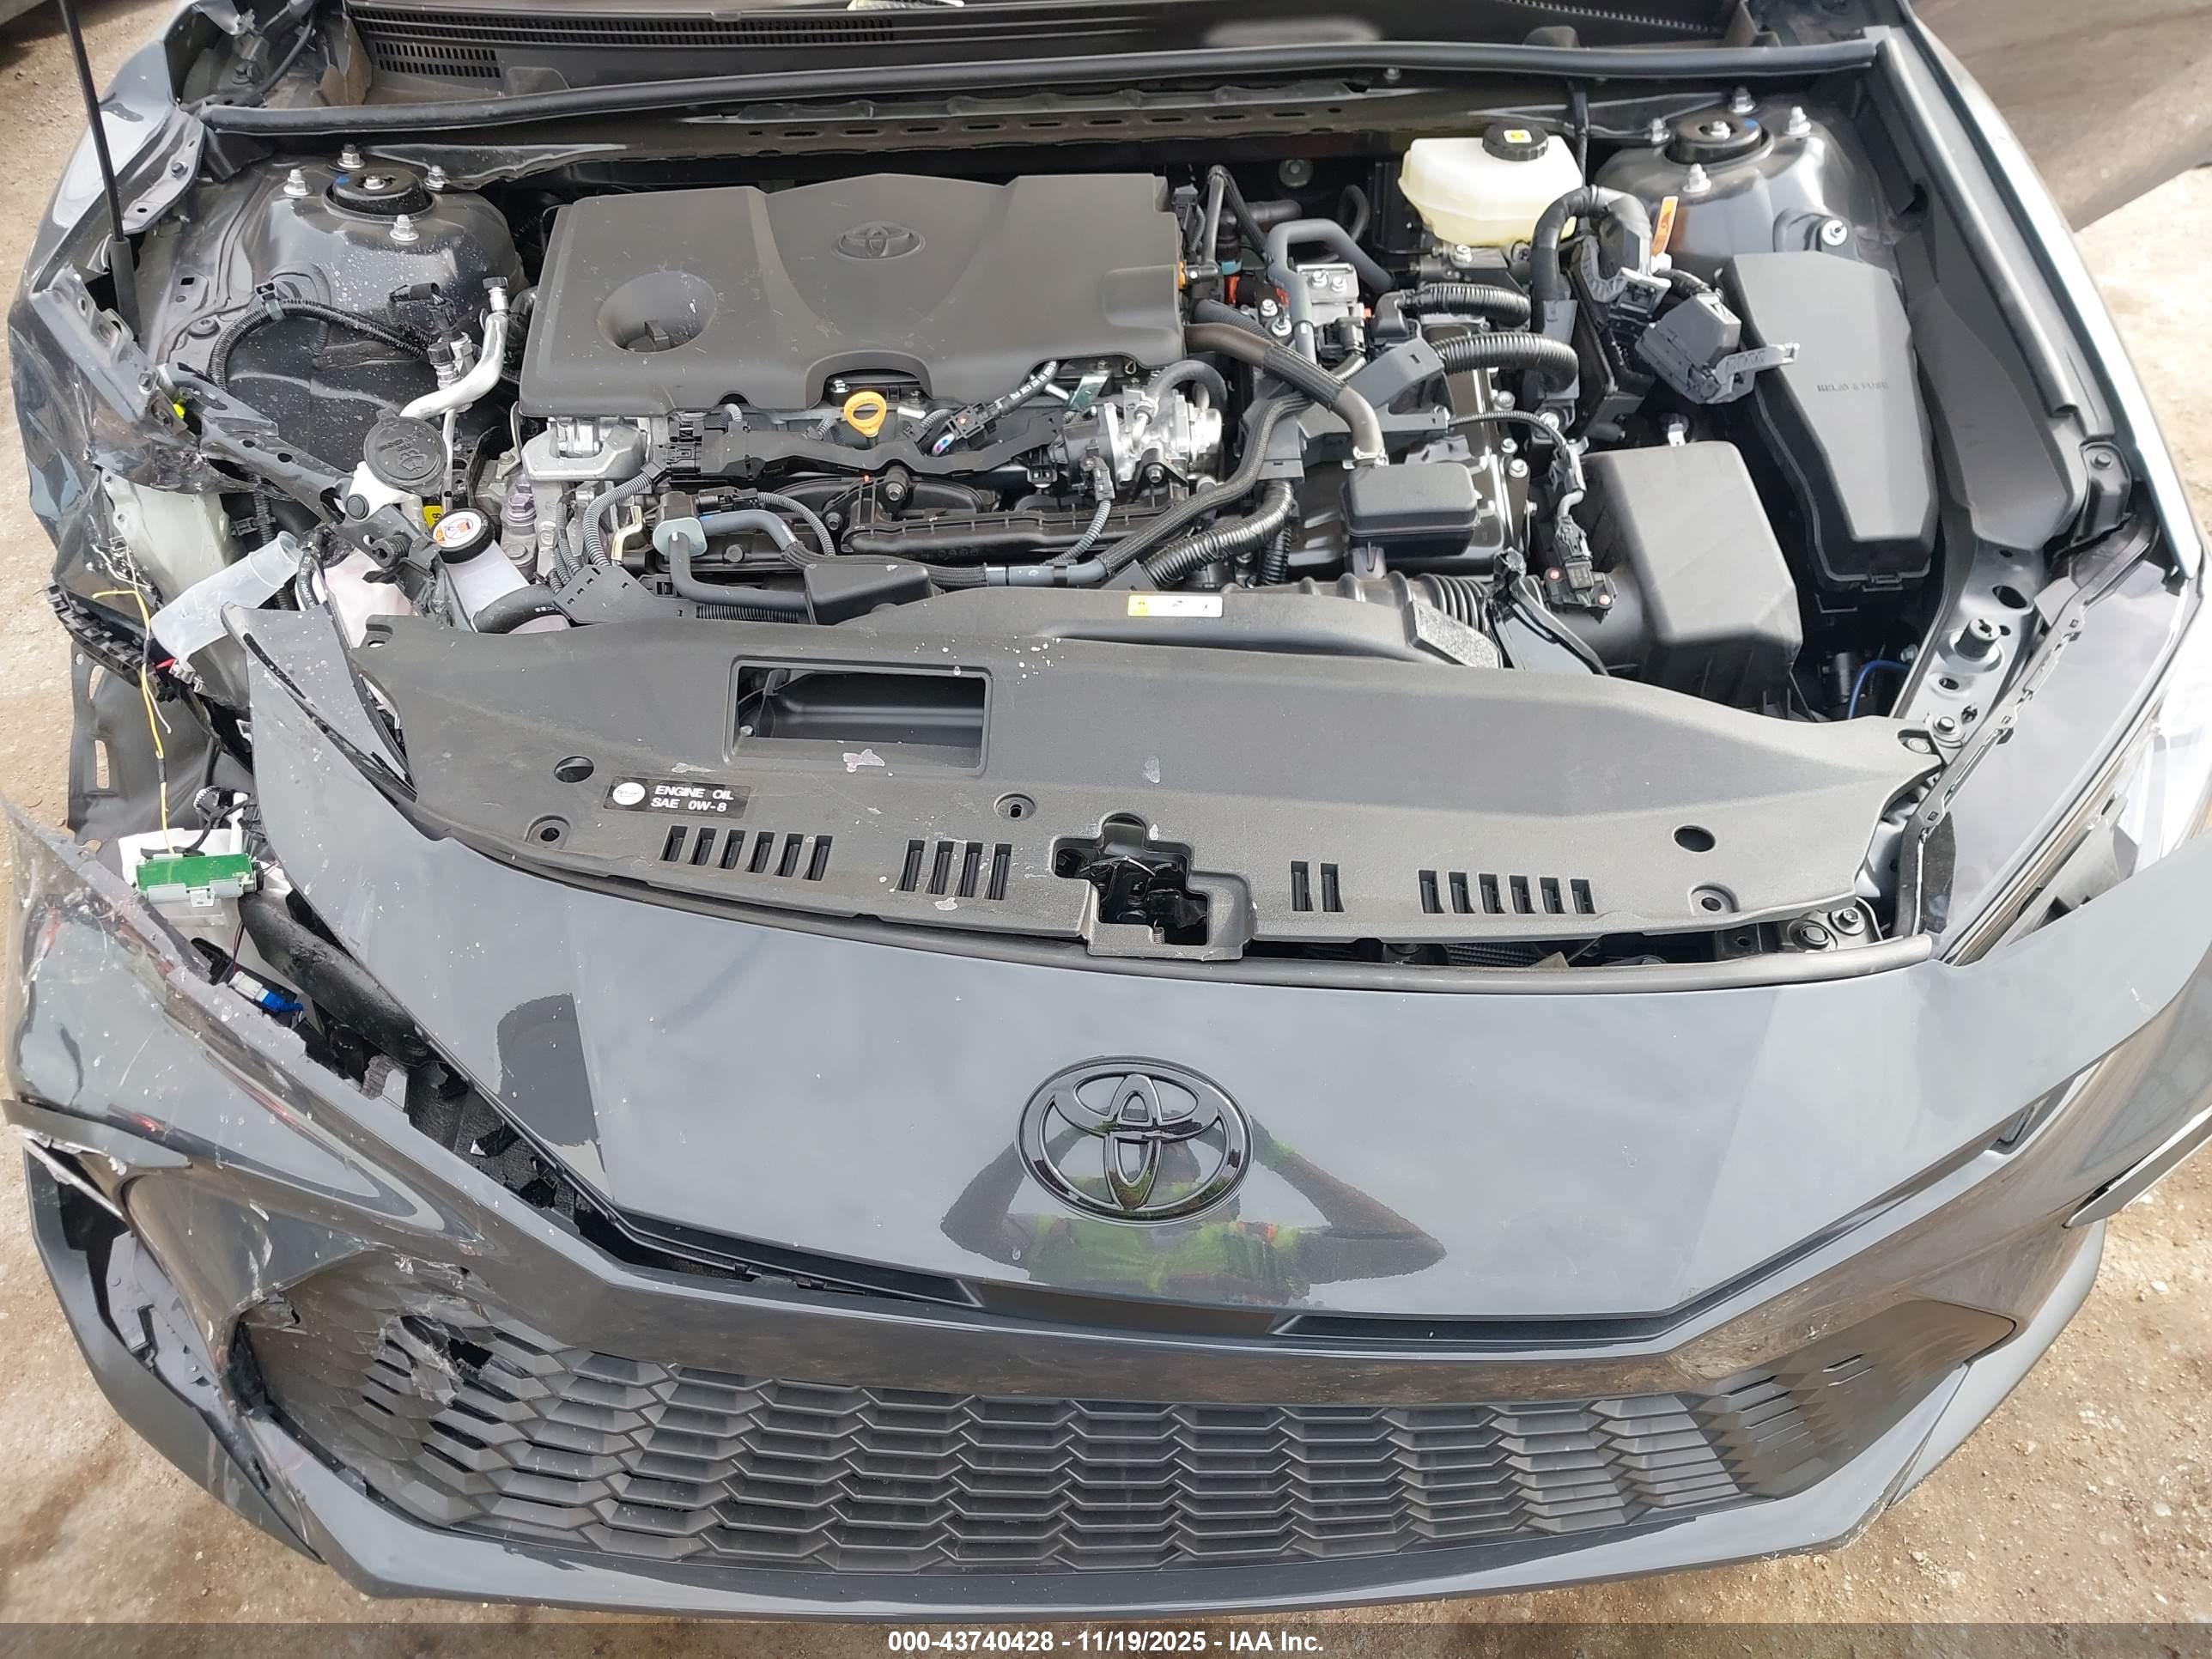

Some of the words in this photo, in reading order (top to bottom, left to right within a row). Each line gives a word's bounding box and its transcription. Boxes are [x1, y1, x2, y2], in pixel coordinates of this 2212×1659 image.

[654, 785, 705, 799] ENGINE
[712, 789, 734, 800] OIL
[651, 798, 680, 809] SAE
[688, 801, 727, 812] 0W-8
